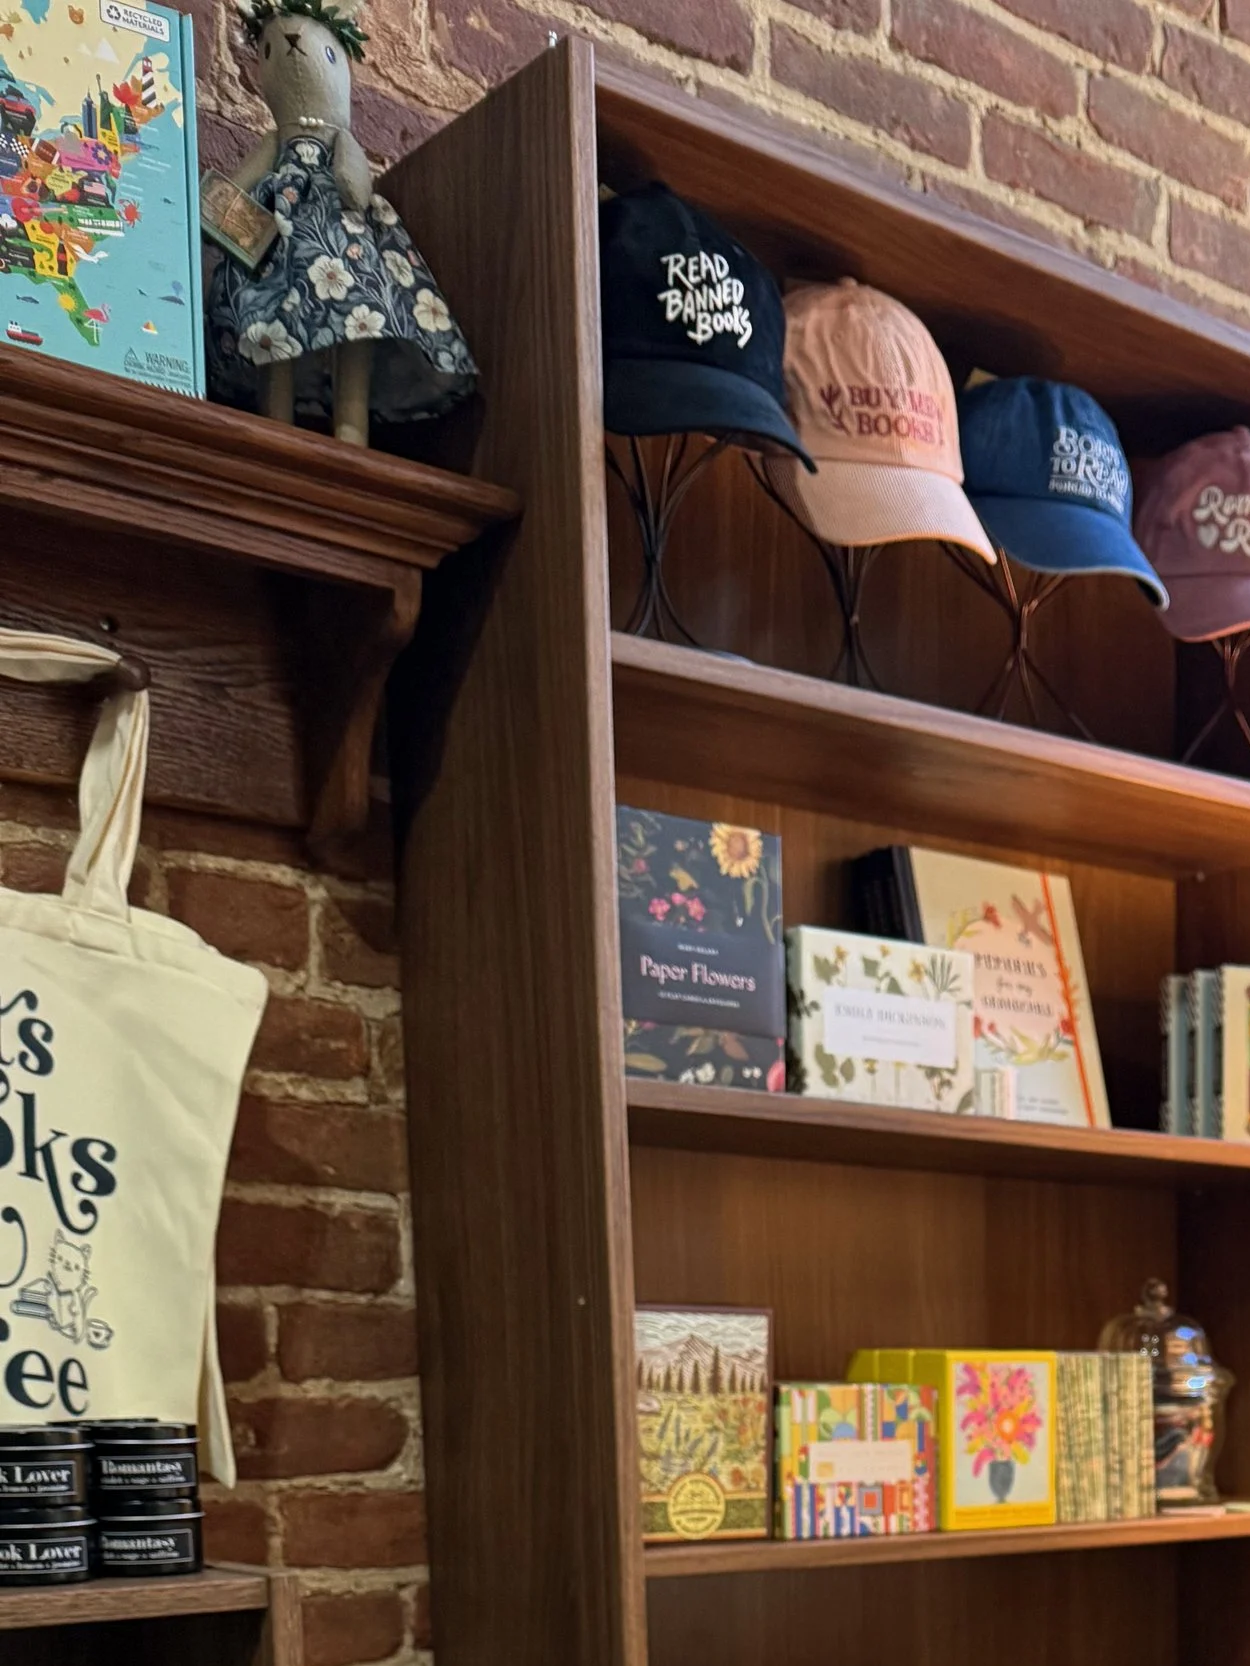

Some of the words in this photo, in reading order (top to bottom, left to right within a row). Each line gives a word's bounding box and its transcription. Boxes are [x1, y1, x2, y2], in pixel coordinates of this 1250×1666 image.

[122, 16, 164, 36] MATERIALS
[123, 8, 163, 27] RECYCLED
[660, 250, 729, 290] READ
[657, 278, 745, 322] BANNED
[687, 305, 753, 349] BOOKS
[848, 385, 900, 410] BUY
[639, 954, 688, 985] Paper
[690, 961, 757, 993] Flowers
[14, 1465, 72, 1484] Lover
[29, 1543, 82, 1561] Lover
